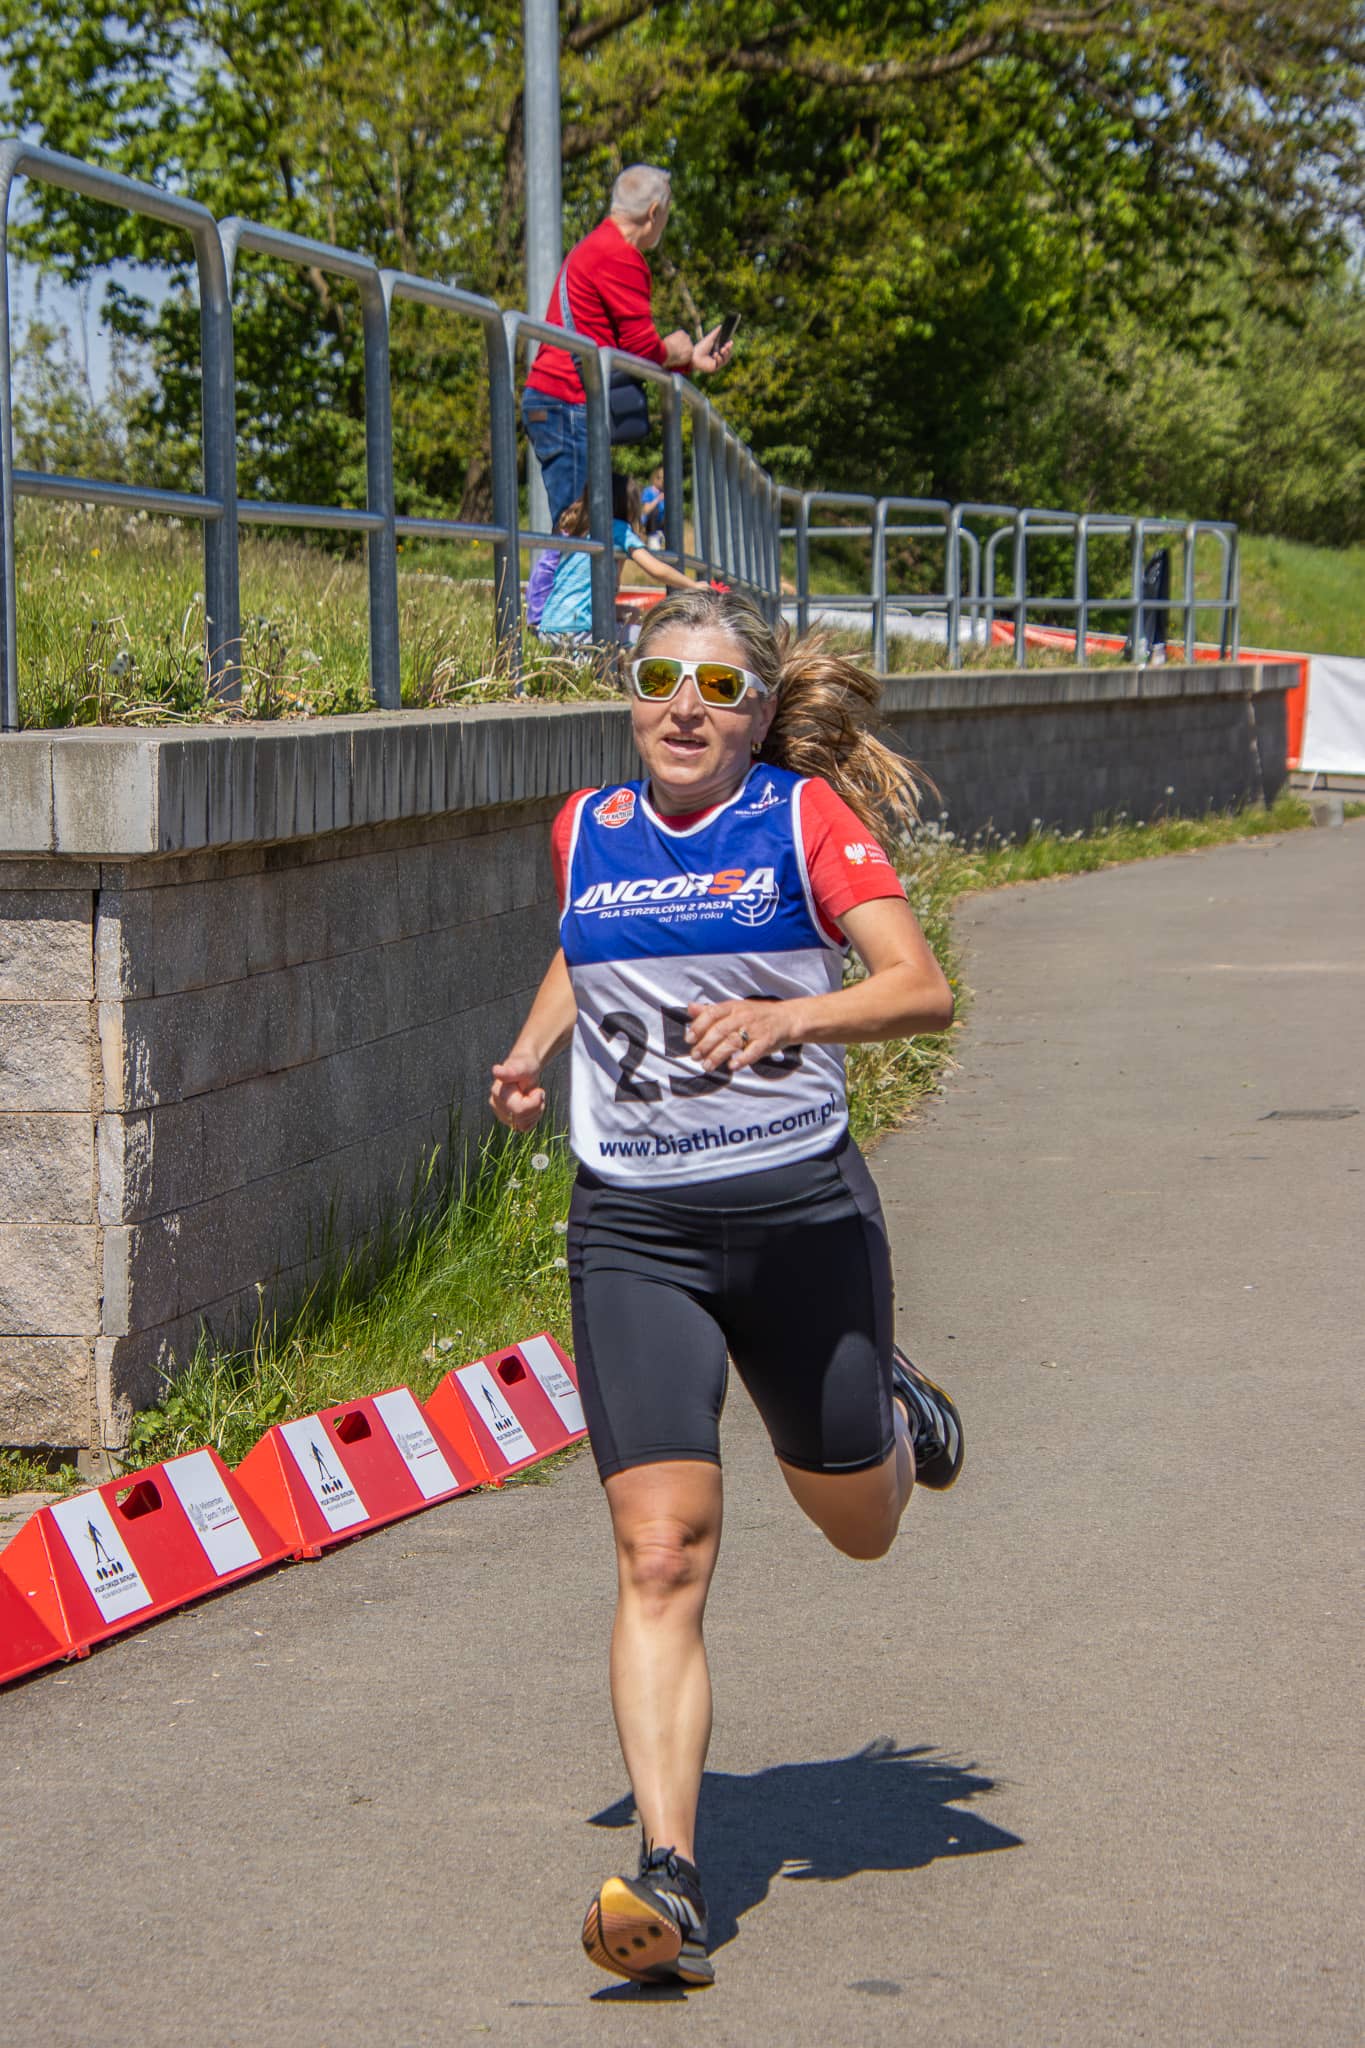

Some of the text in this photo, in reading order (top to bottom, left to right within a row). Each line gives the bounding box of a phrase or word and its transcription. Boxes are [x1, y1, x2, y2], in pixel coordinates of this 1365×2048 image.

[574, 867, 775, 908] INCORSA
[600, 911, 620, 919] DLA
[622, 904, 686, 917] STRZELCÓW
[687, 903, 695, 911] Z
[659, 911, 724, 923] od 1989 roku
[600, 1093, 836, 1157] www.biathlon.com.pl
